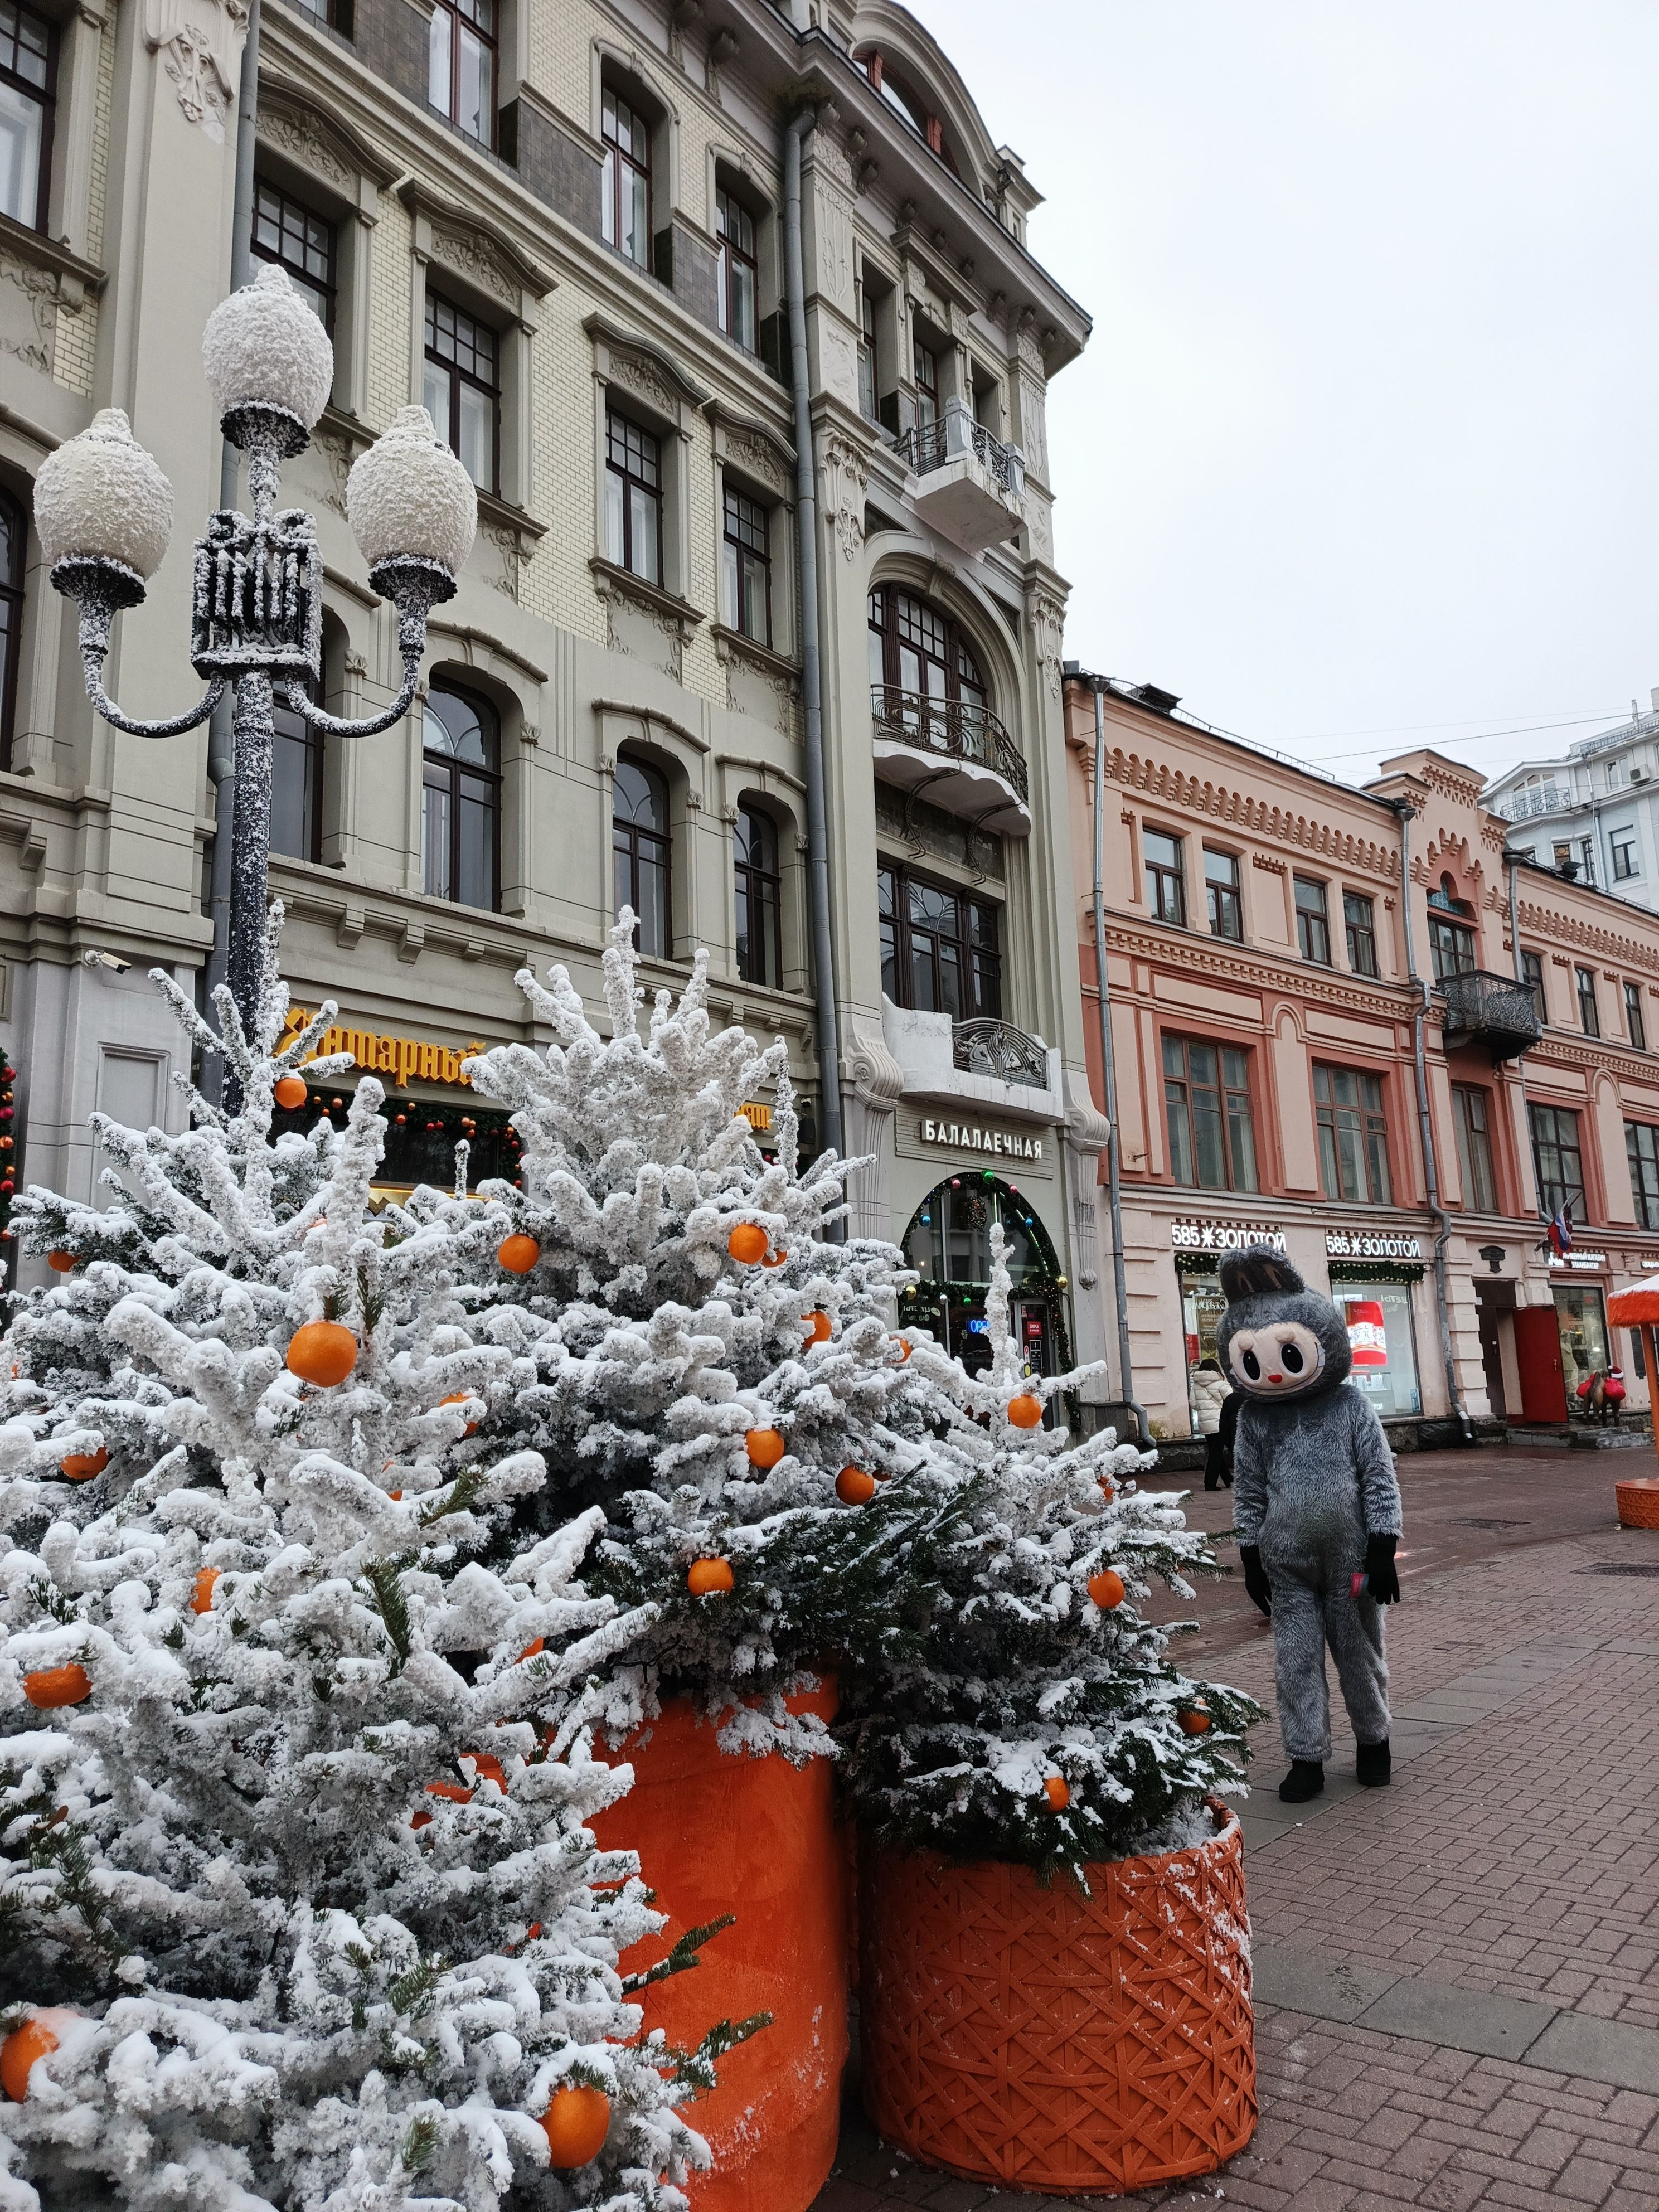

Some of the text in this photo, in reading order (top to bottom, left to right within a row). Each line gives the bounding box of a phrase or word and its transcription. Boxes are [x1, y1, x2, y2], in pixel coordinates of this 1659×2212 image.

[922, 1119, 1042, 1160] БАЛАЛАЕЧНАЯ
[1172, 1224, 1287, 1251] 585 ЗОЛОТОЙ
[1326, 1235, 1421, 1258] 585 ЗОЛОТОЙ
